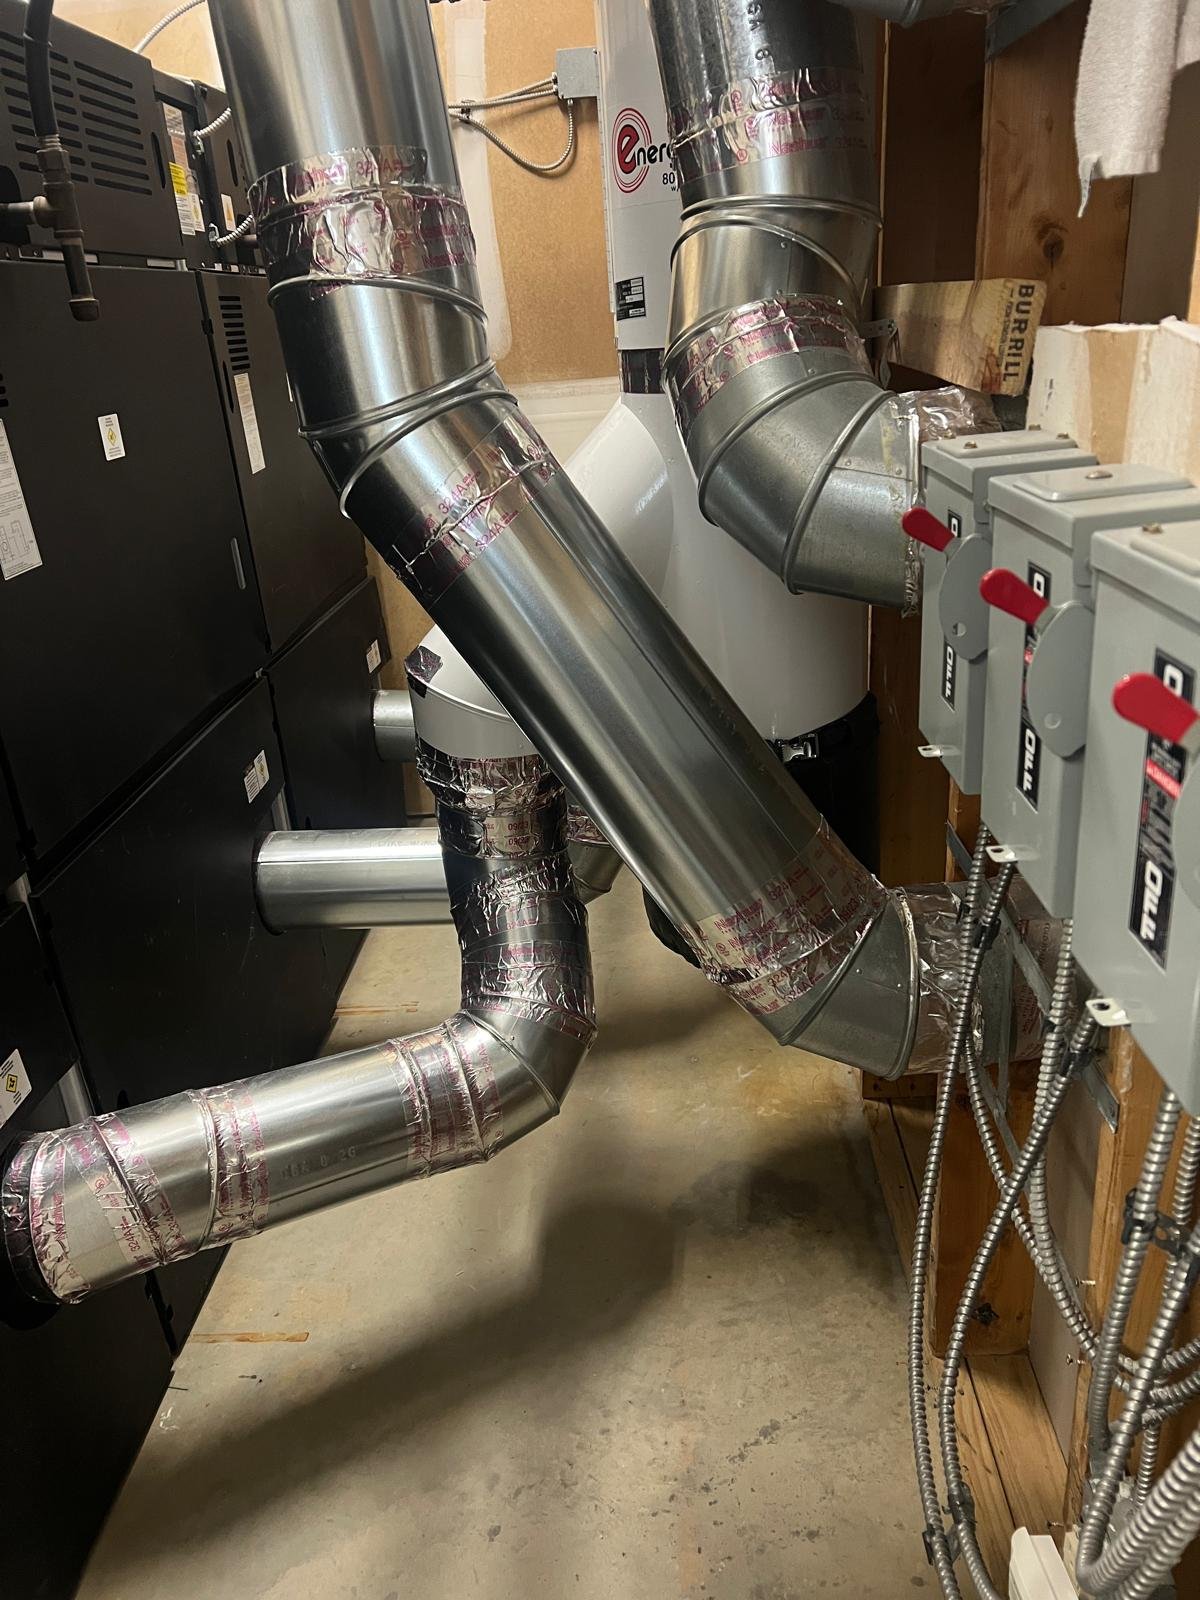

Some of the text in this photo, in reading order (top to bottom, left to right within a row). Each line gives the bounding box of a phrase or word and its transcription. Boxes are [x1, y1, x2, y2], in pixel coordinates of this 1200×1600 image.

[1003, 285, 1035, 382] BURRILL
[945, 645, 954, 698] OFF
[1022, 728, 1036, 791] OFF
[1140, 860, 1163, 941] OFF
